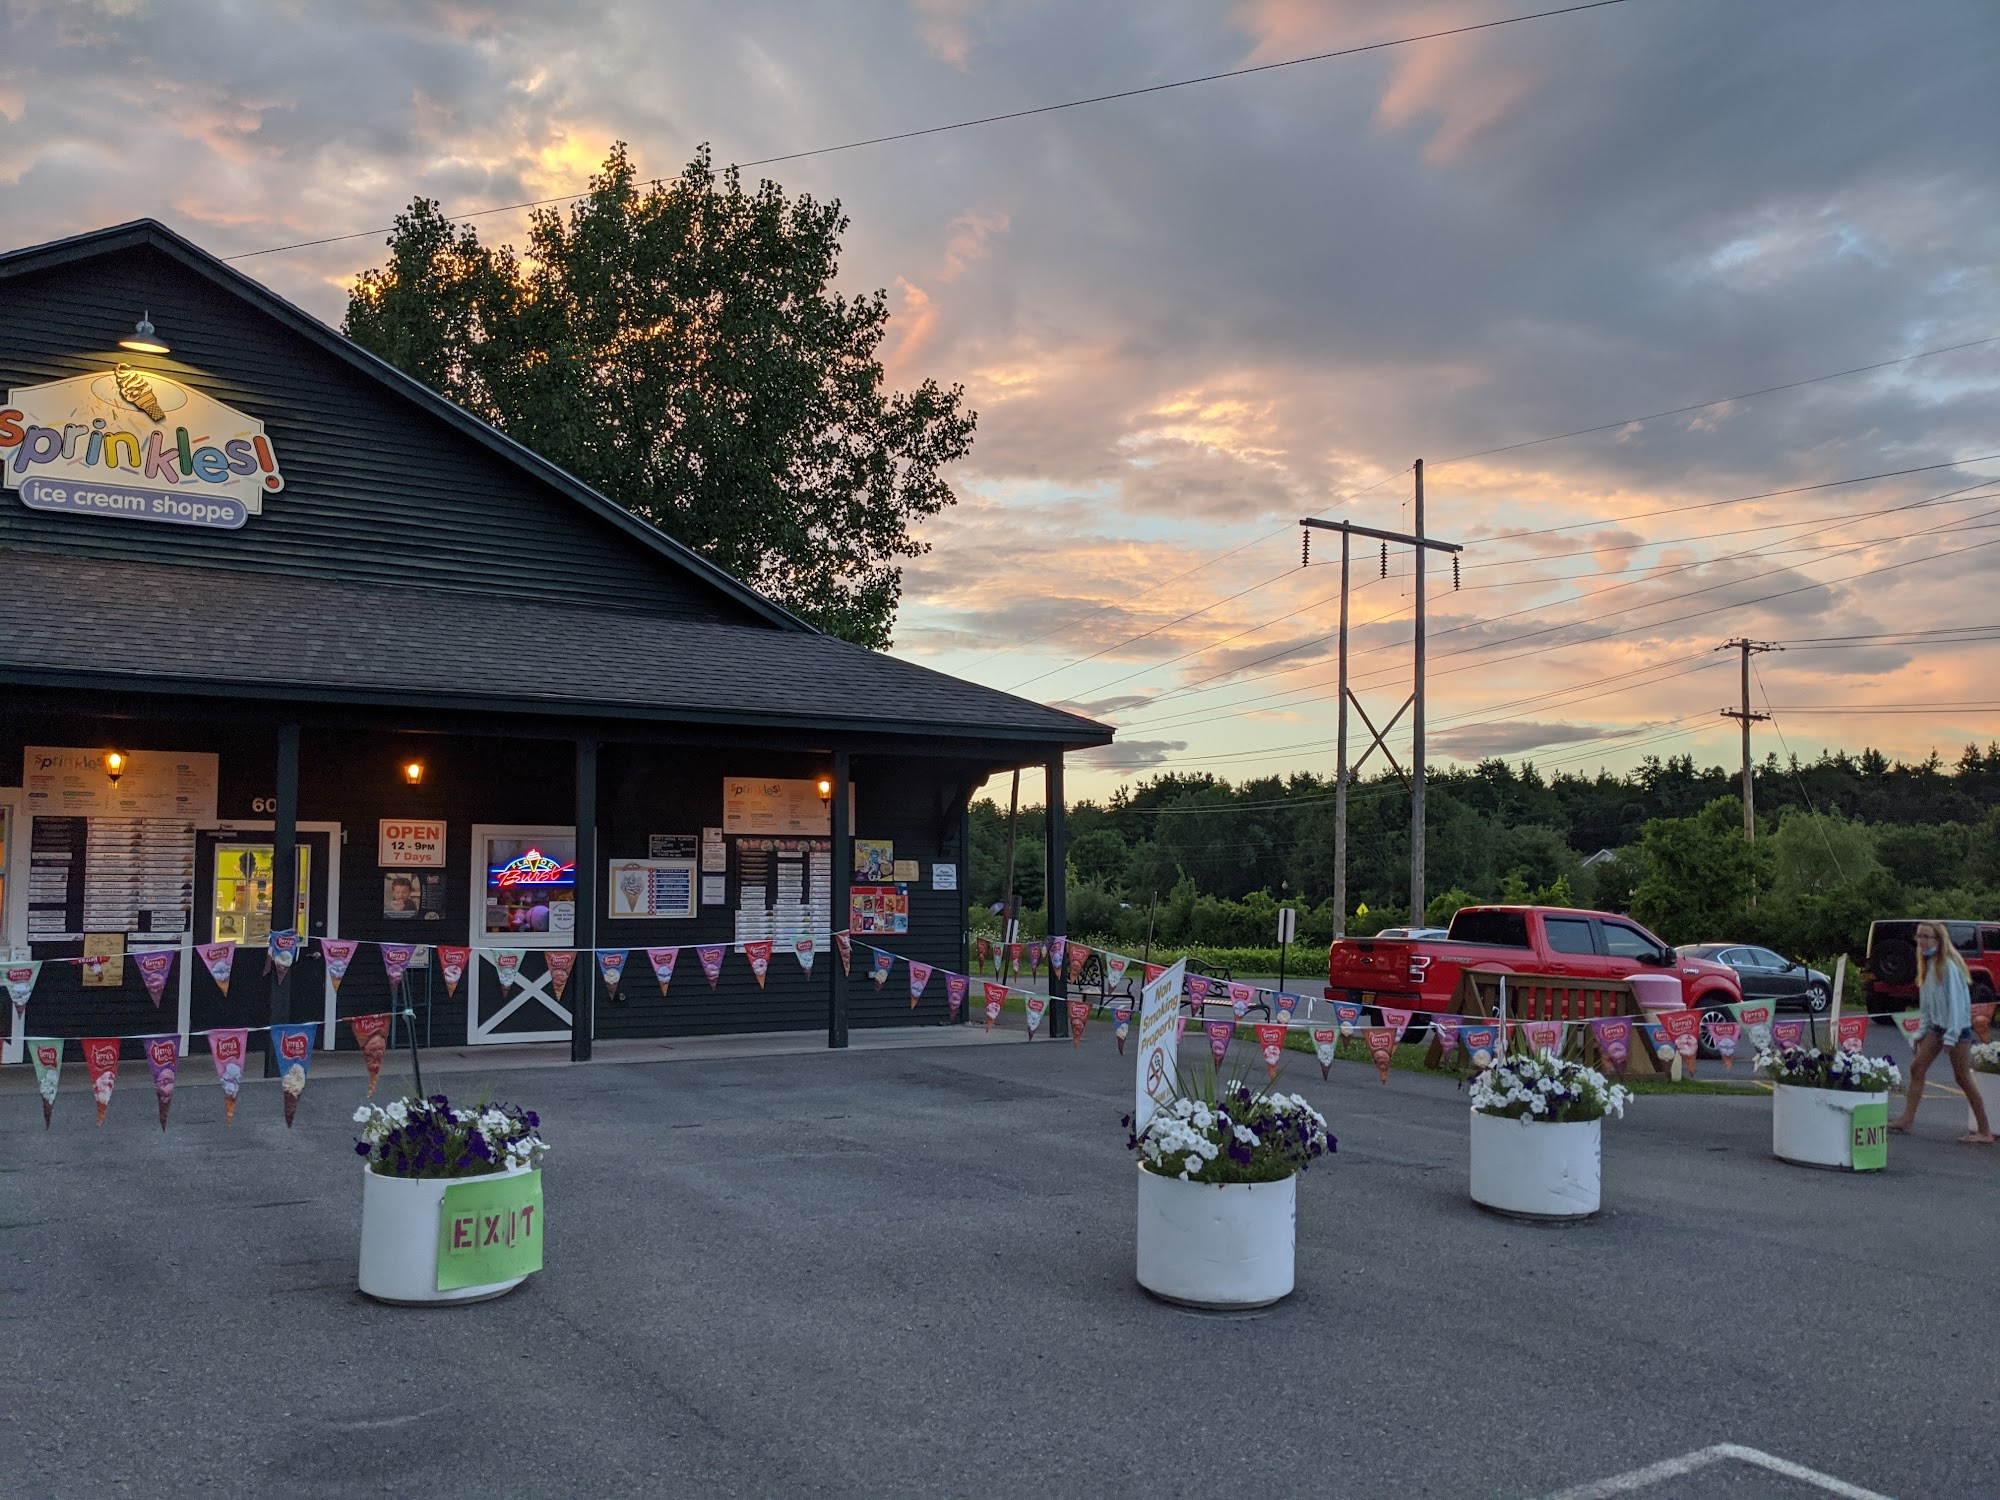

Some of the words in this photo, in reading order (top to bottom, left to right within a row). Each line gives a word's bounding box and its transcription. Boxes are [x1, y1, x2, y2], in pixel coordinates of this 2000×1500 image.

[33, 482, 67, 503] ice
[74, 489, 146, 511] cream
[152, 496, 235, 523] shoppe
[386, 826, 440, 840] OPEN
[391, 841, 405, 850] 12
[414, 842, 435, 851] 9PM
[393, 852, 401, 860] 7
[404, 852, 432, 863] Days
[497, 864, 575, 887] Burst
[1154, 980, 1172, 1004] Non
[1142, 994, 1179, 1033] Smoking
[1140, 1014, 1177, 1055] Property
[454, 1205, 535, 1248] EXIT
